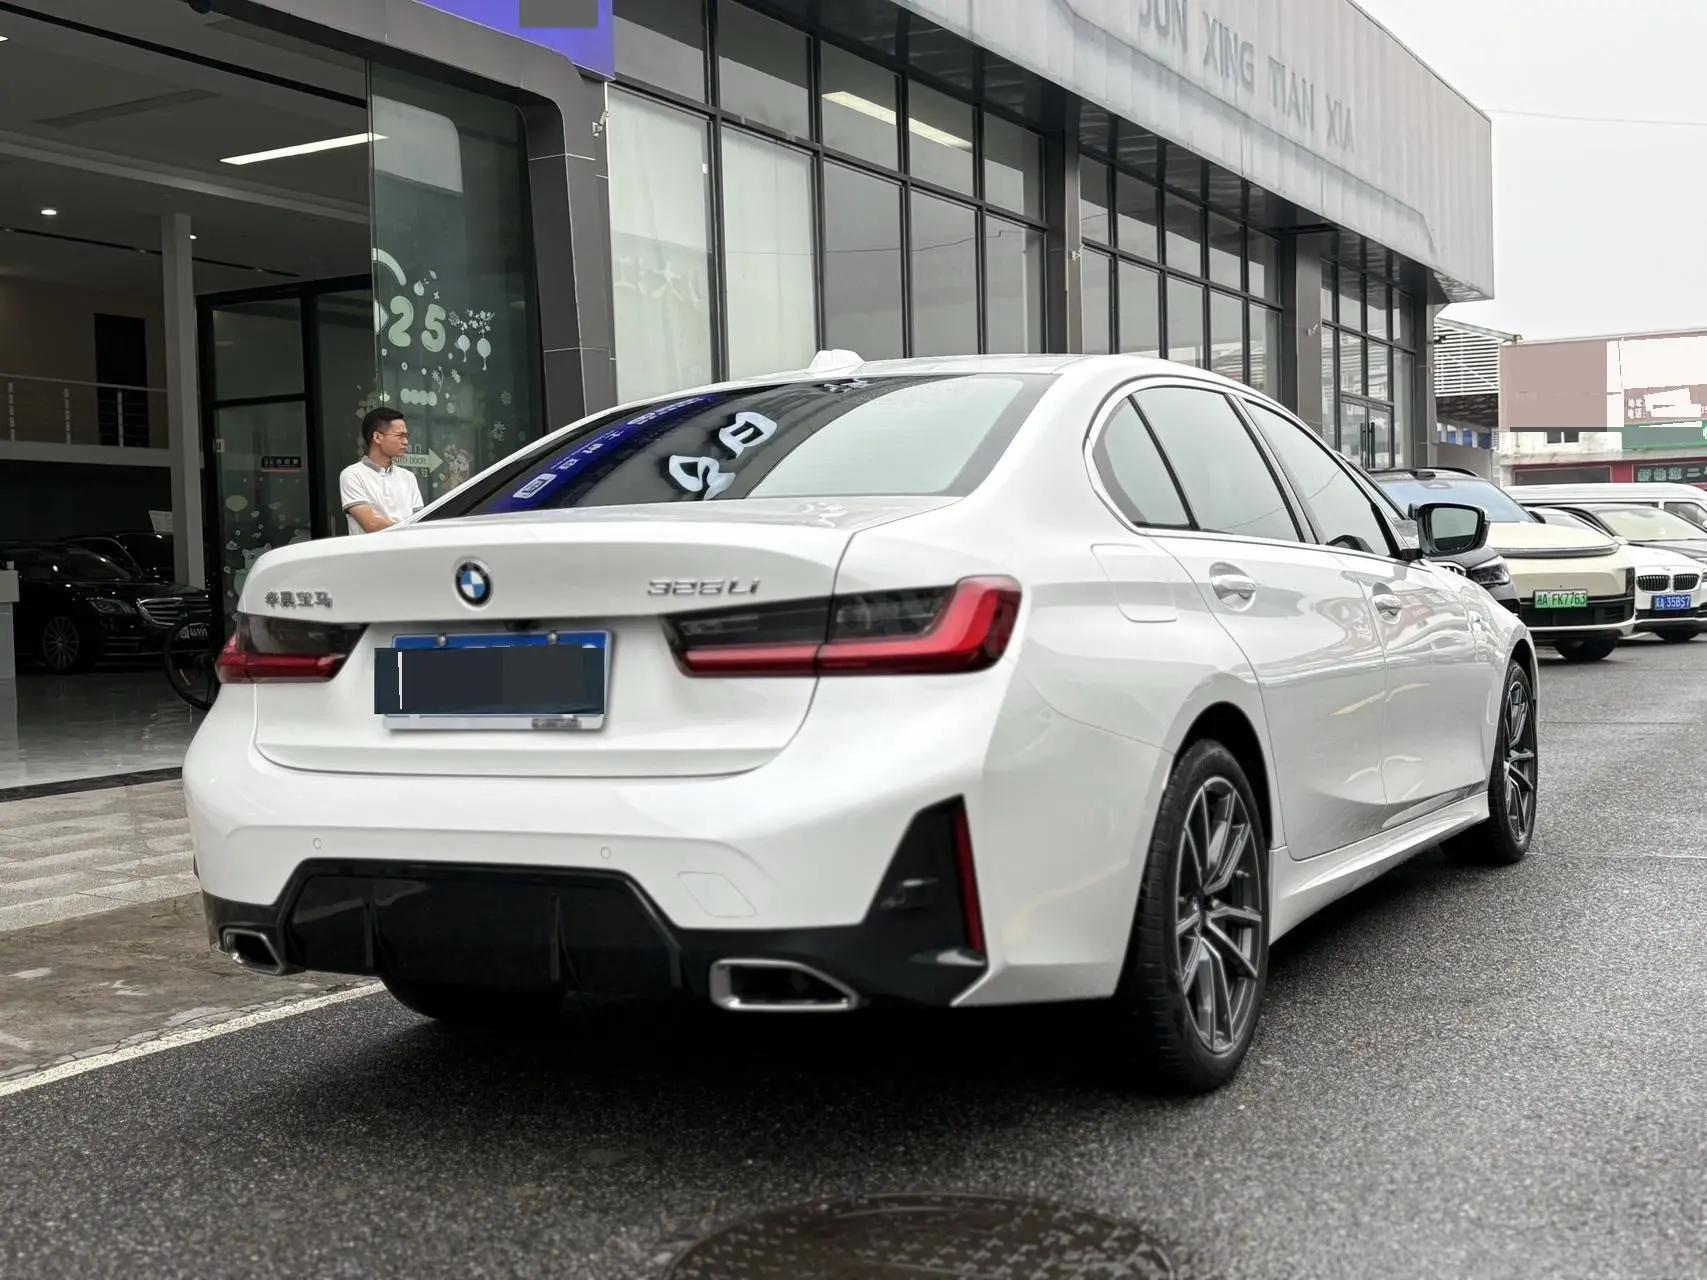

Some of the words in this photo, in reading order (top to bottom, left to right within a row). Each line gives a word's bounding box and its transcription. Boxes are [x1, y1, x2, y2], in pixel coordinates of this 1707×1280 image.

[1202, 10, 1254, 95] XING
[1268, 55, 1314, 132] TIAN
[1326, 92, 1355, 153] XIA
